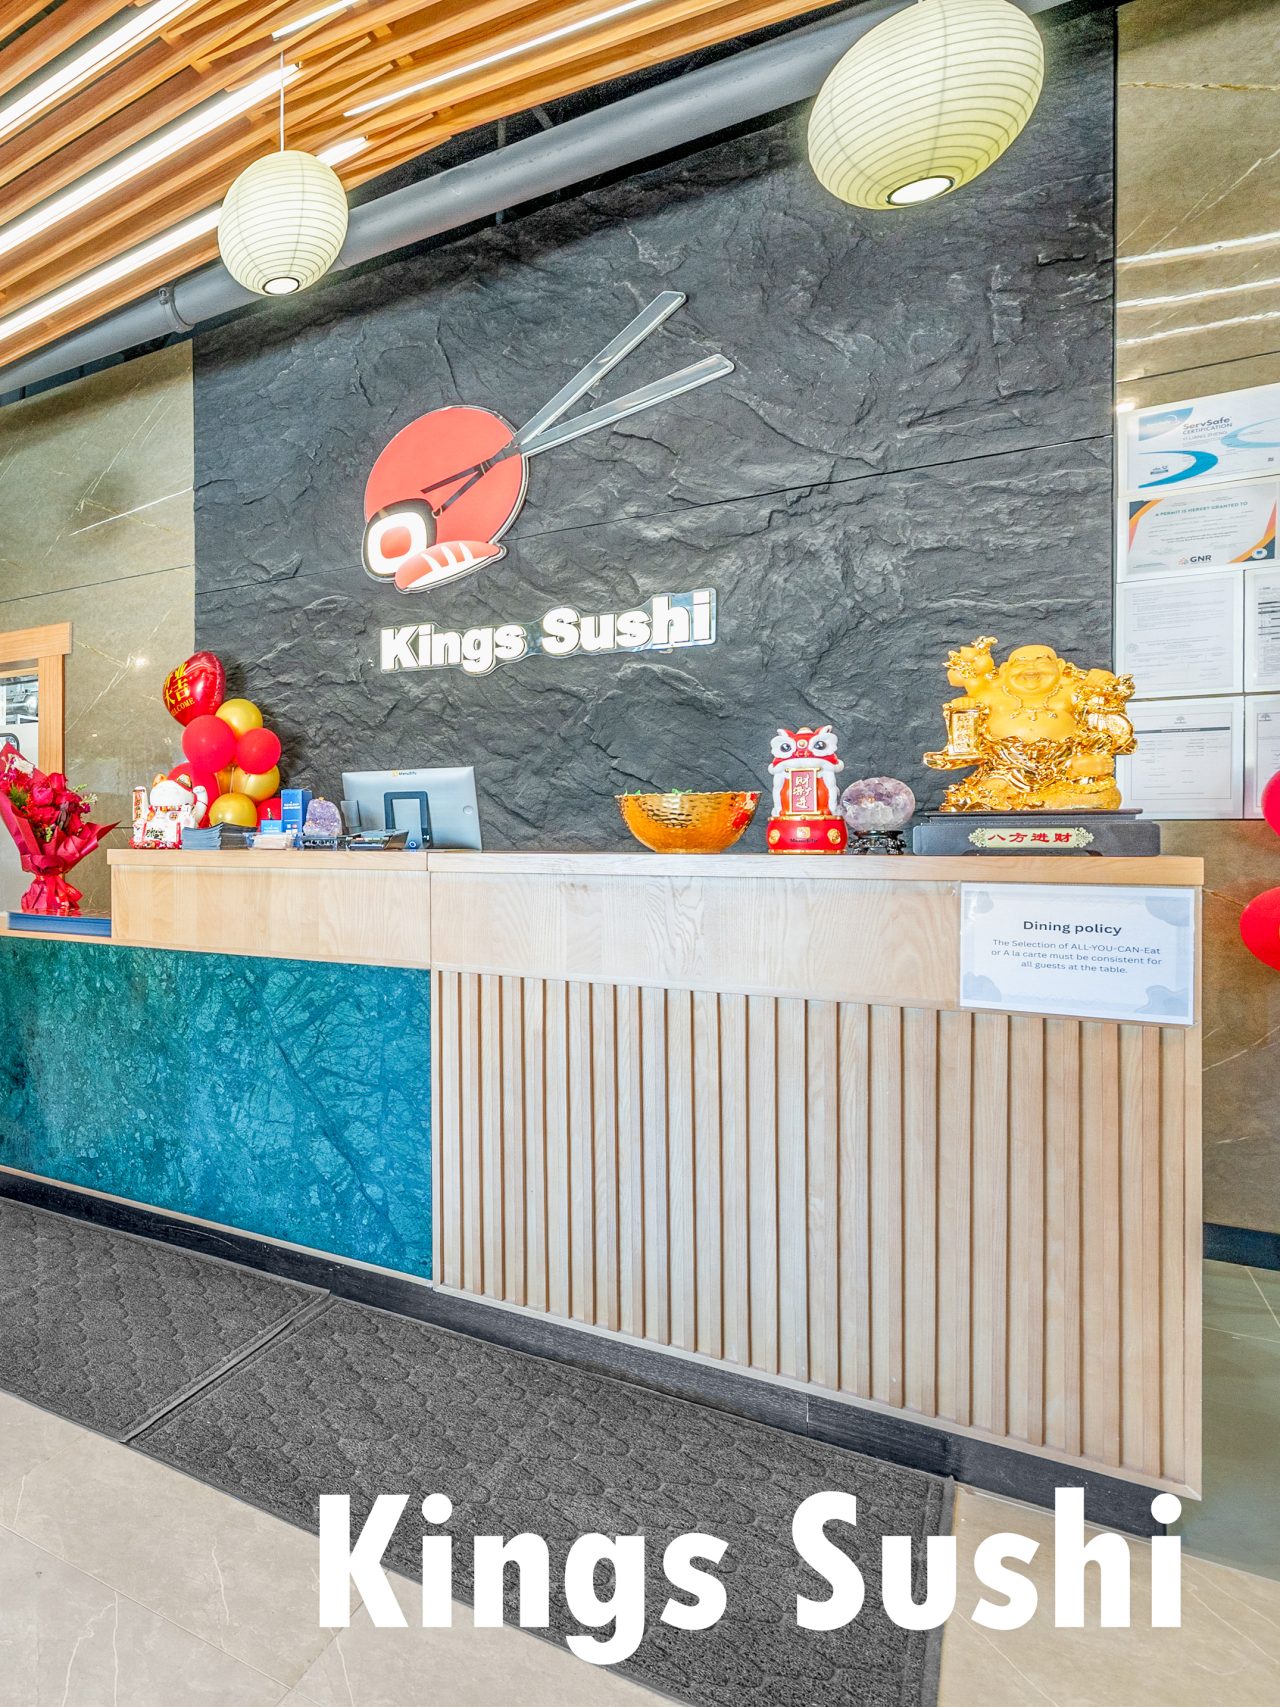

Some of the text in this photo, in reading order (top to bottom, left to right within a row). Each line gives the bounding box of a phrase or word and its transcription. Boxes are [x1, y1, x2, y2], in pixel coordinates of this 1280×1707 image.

[1182, 423, 1233, 435] CERTIFICATION
[1183, 417, 1231, 430] ServSafe
[1190, 555, 1212, 563] GNR
[381, 590, 712, 675] Kings Sushi
[1023, 920, 1122, 937] Dining policy
[993, 939, 1161, 955] The Selection of ALL-YOU-CAN-Eat
[1012, 949, 1020, 957] la
[1022, 951, 1047, 959] carte
[1076, 953, 1089, 961] be
[1091, 954, 1145, 965] consistent
[1147, 956, 1162, 965] for
[1021, 960, 1128, 974] all guests at the table.
